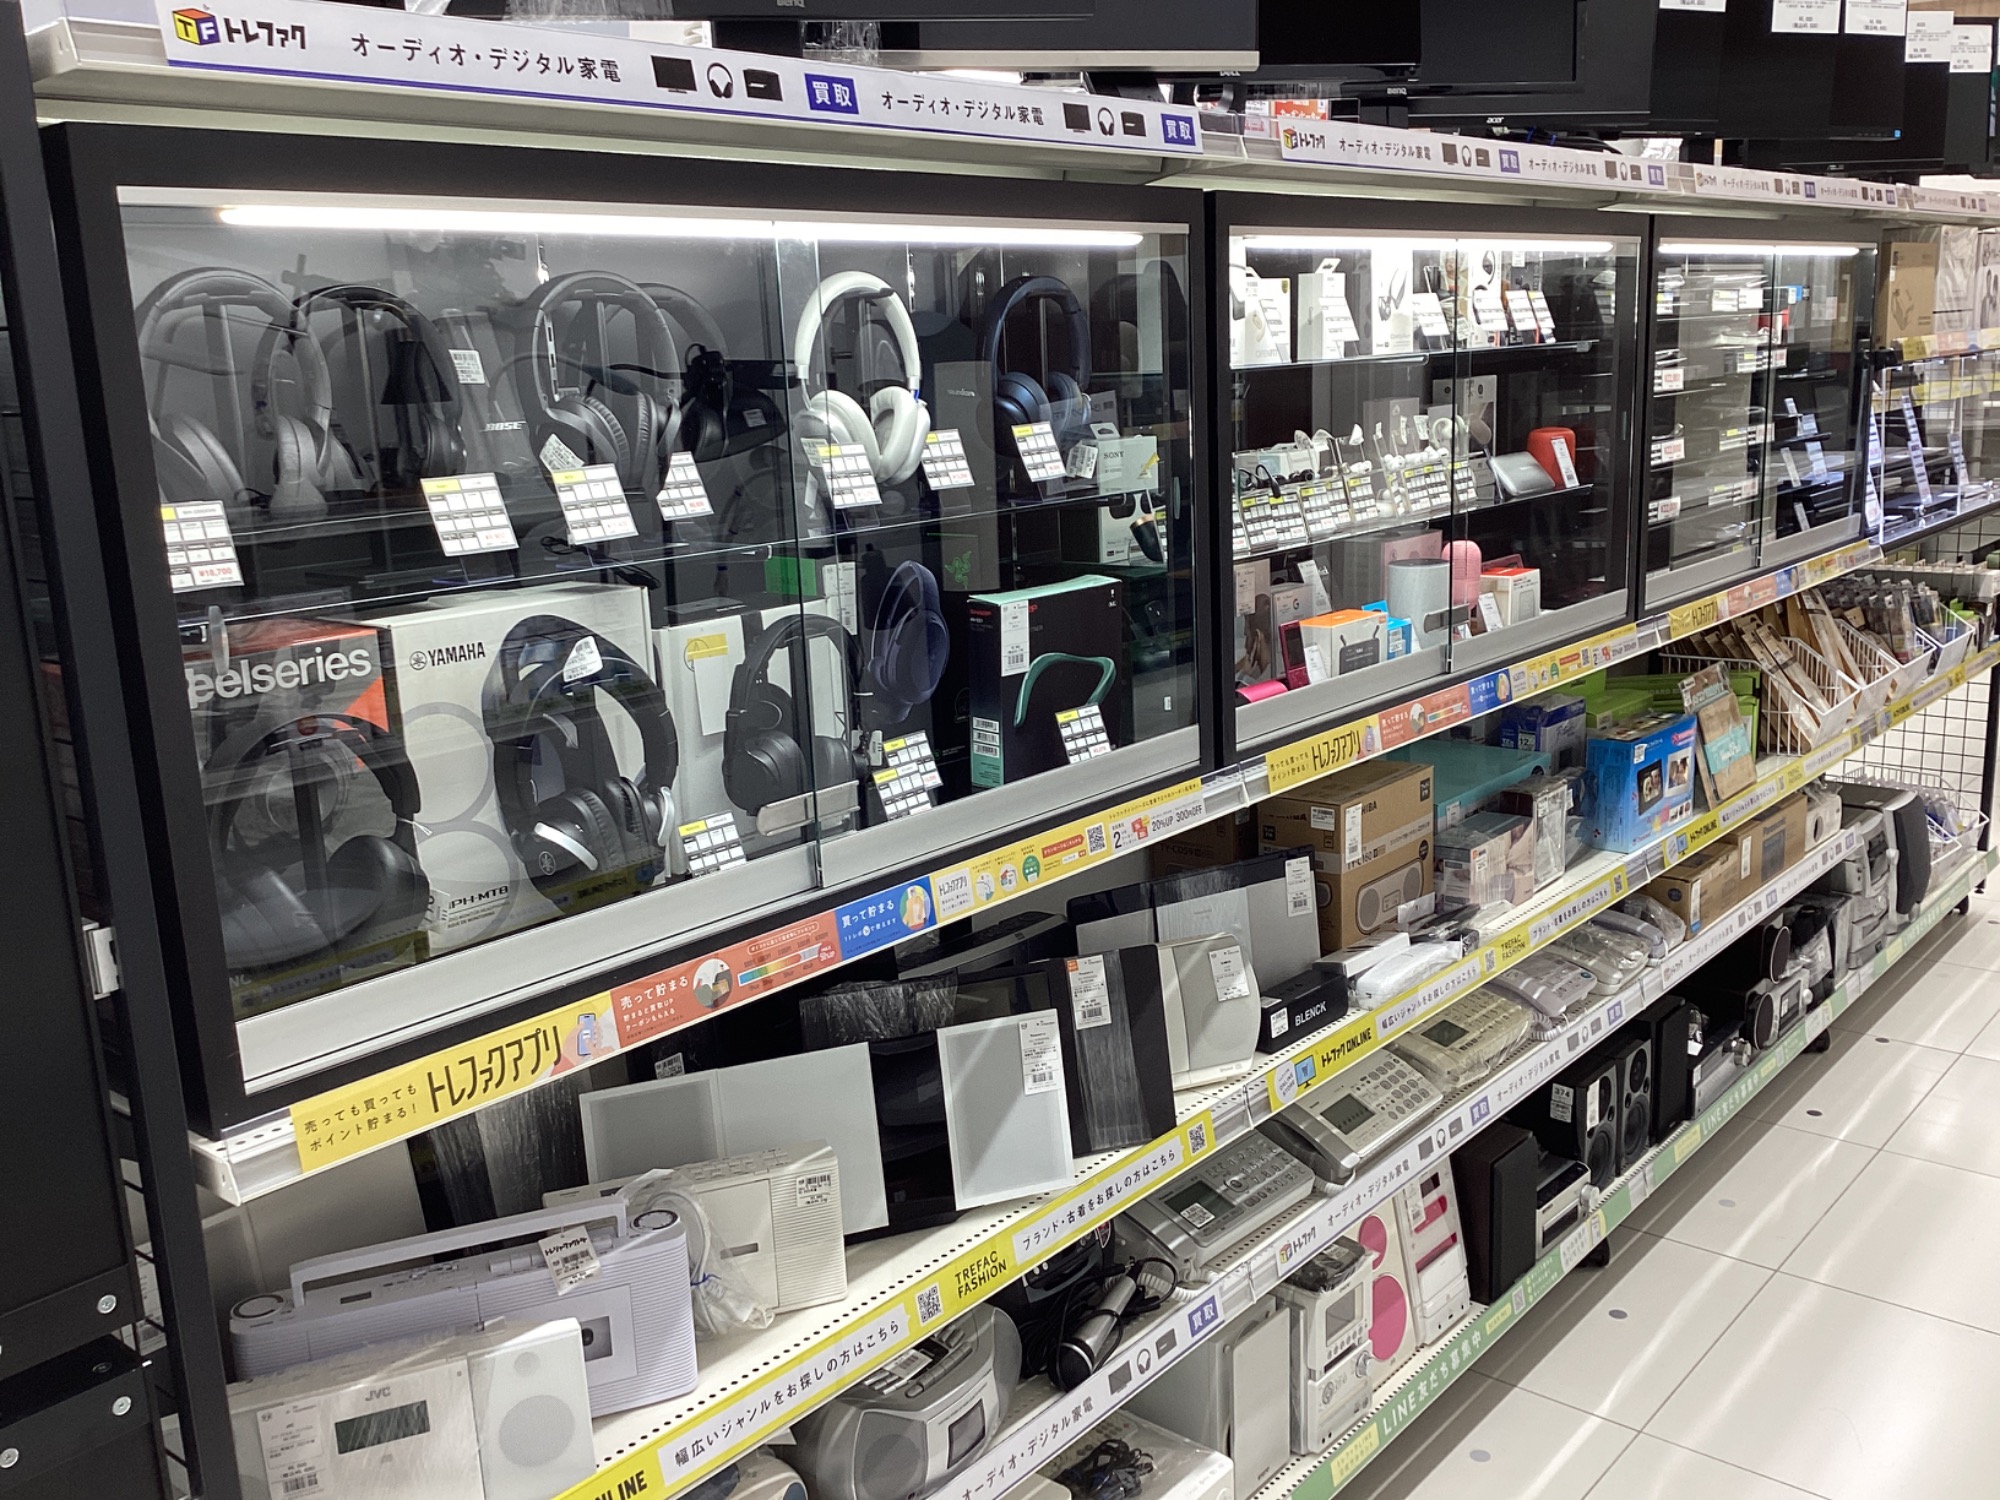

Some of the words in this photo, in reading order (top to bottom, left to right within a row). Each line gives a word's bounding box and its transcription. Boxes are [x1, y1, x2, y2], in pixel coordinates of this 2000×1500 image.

[224, 15, 305, 51] トレファク
[351, 32, 621, 84] オーディオ・デジタル家電
[812, 81, 852, 108] 買取
[881, 89, 1044, 127] オーディオ・デジタル家電
[1165, 117, 1193, 142] 買取
[1486, 116, 1504, 124] acer
[1299, 132, 1326, 149] トレファク
[1339, 138, 1431, 160] オーディオ・デジタル家電
[1500, 153, 1519, 169] 買取
[1103, 451, 1124, 459] SONY
[428, 641, 486, 667] YAMAHA
[1311, 730, 1361, 771] トレファクアプリ
[1113, 831, 1122, 849] 2
[842, 900, 894, 929] 買って貯まる
[1501, 934, 1522, 951] TREFAC
[1502, 942, 1526, 961] FASHION
[620, 975, 689, 1011] 売って貯まる
[623, 998, 674, 1022] 貯まると買取UP
[625, 1007, 676, 1032] クーポンもらえる
[1294, 1001, 1327, 1027] BLENCK
[1321, 1045, 1346, 1068] トレファク
[1346, 1027, 1371, 1052] ONLINE
[427, 1026, 561, 1114] トレファクアプリ
[1496, 1048, 1561, 1102] オーディオ・デジタル家電
[1555, 1087, 1570, 1098] 374
[304, 1083, 417, 1135] 売っても買っても
[1022, 1149, 1176, 1252] ブランド・古着をお探しの方はこちら
[1327, 1159, 1410, 1227] オーディオ・デジタル家電
[1293, 1226, 1316, 1254] トレファク
[954, 1250, 999, 1286] TREFAC
[957, 1259, 1007, 1300] FASHION
[1193, 1301, 1215, 1330] 買取
[365, 1387, 391, 1401] JVC
[674, 1319, 900, 1469] 幅広いジャンルをお探しの方はこちら
[1382, 1330, 1482, 1436] LINE友だち募集中
[962, 1395, 1094, 1500] オーディオ・デジタル家電
